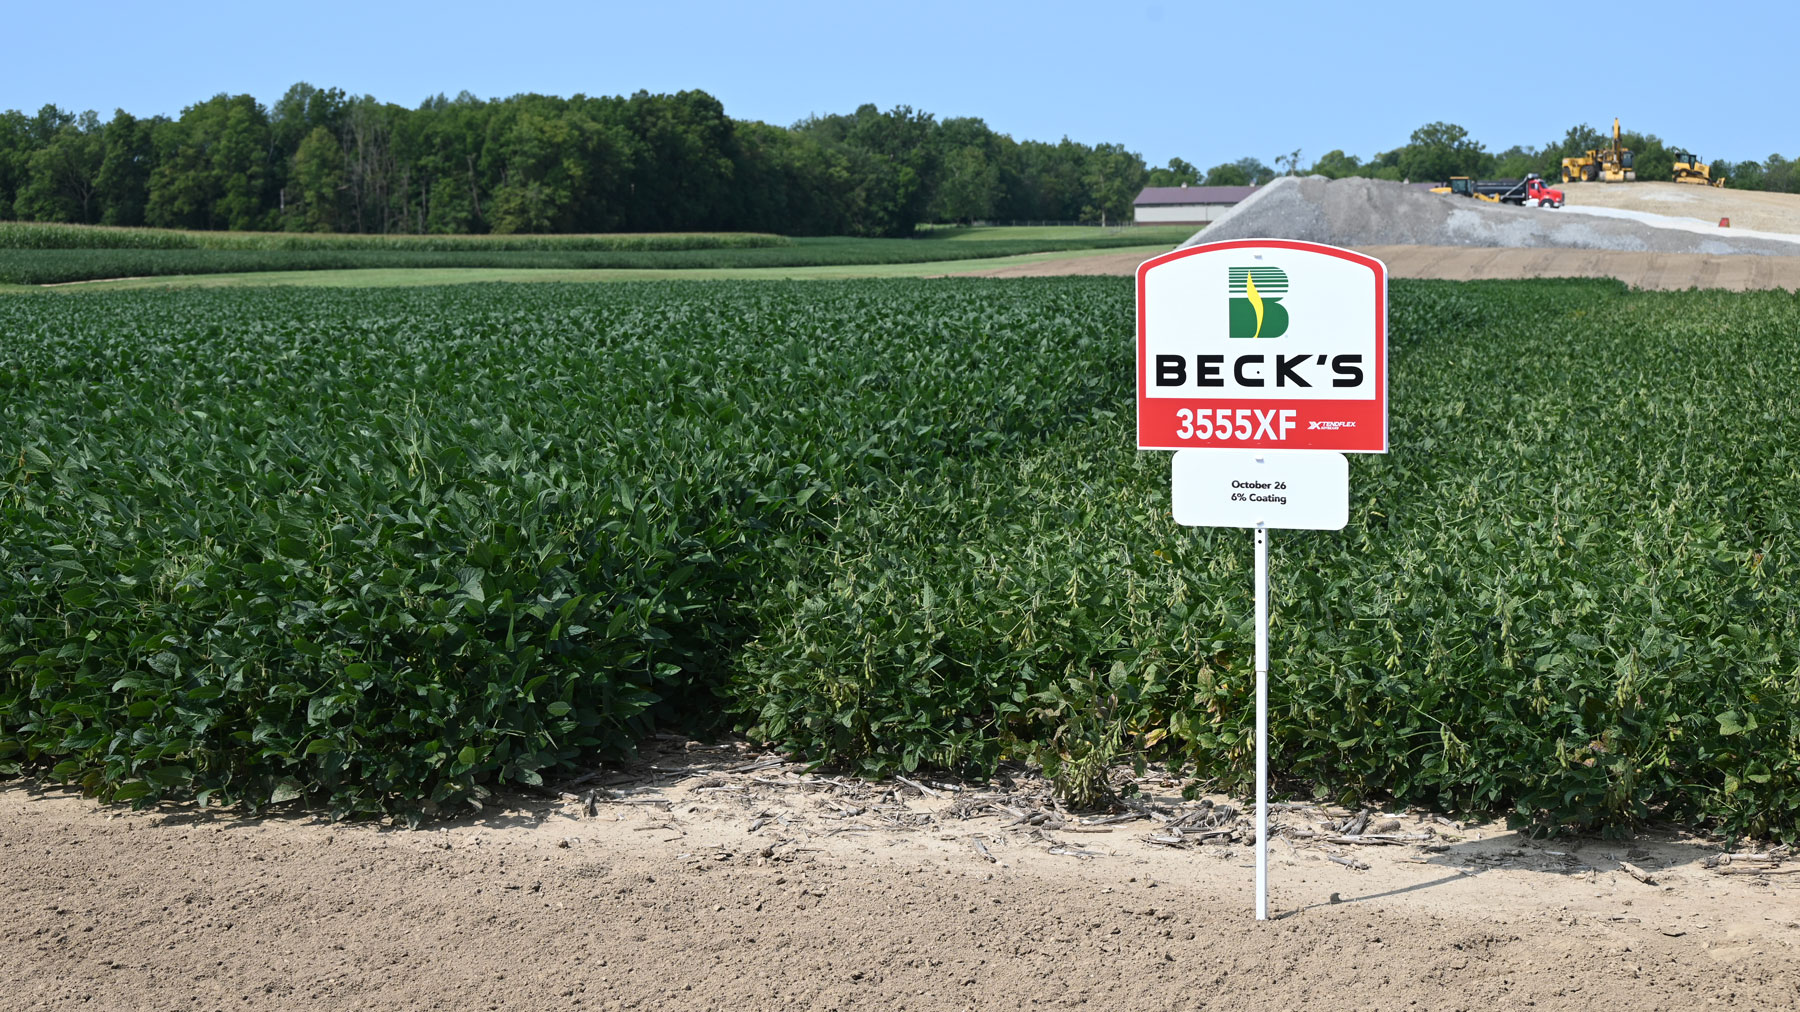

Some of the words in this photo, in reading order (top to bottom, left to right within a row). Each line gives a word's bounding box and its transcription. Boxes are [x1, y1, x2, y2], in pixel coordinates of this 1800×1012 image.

[1156, 354, 1364, 388] BECK'S
[1176, 408, 1297, 440] 3555XF
[1231, 480, 1272, 489] October
[1274, 481, 1287, 490] 26
[1230, 493, 1247, 502] 6%
[1249, 493, 1287, 505] Coating
